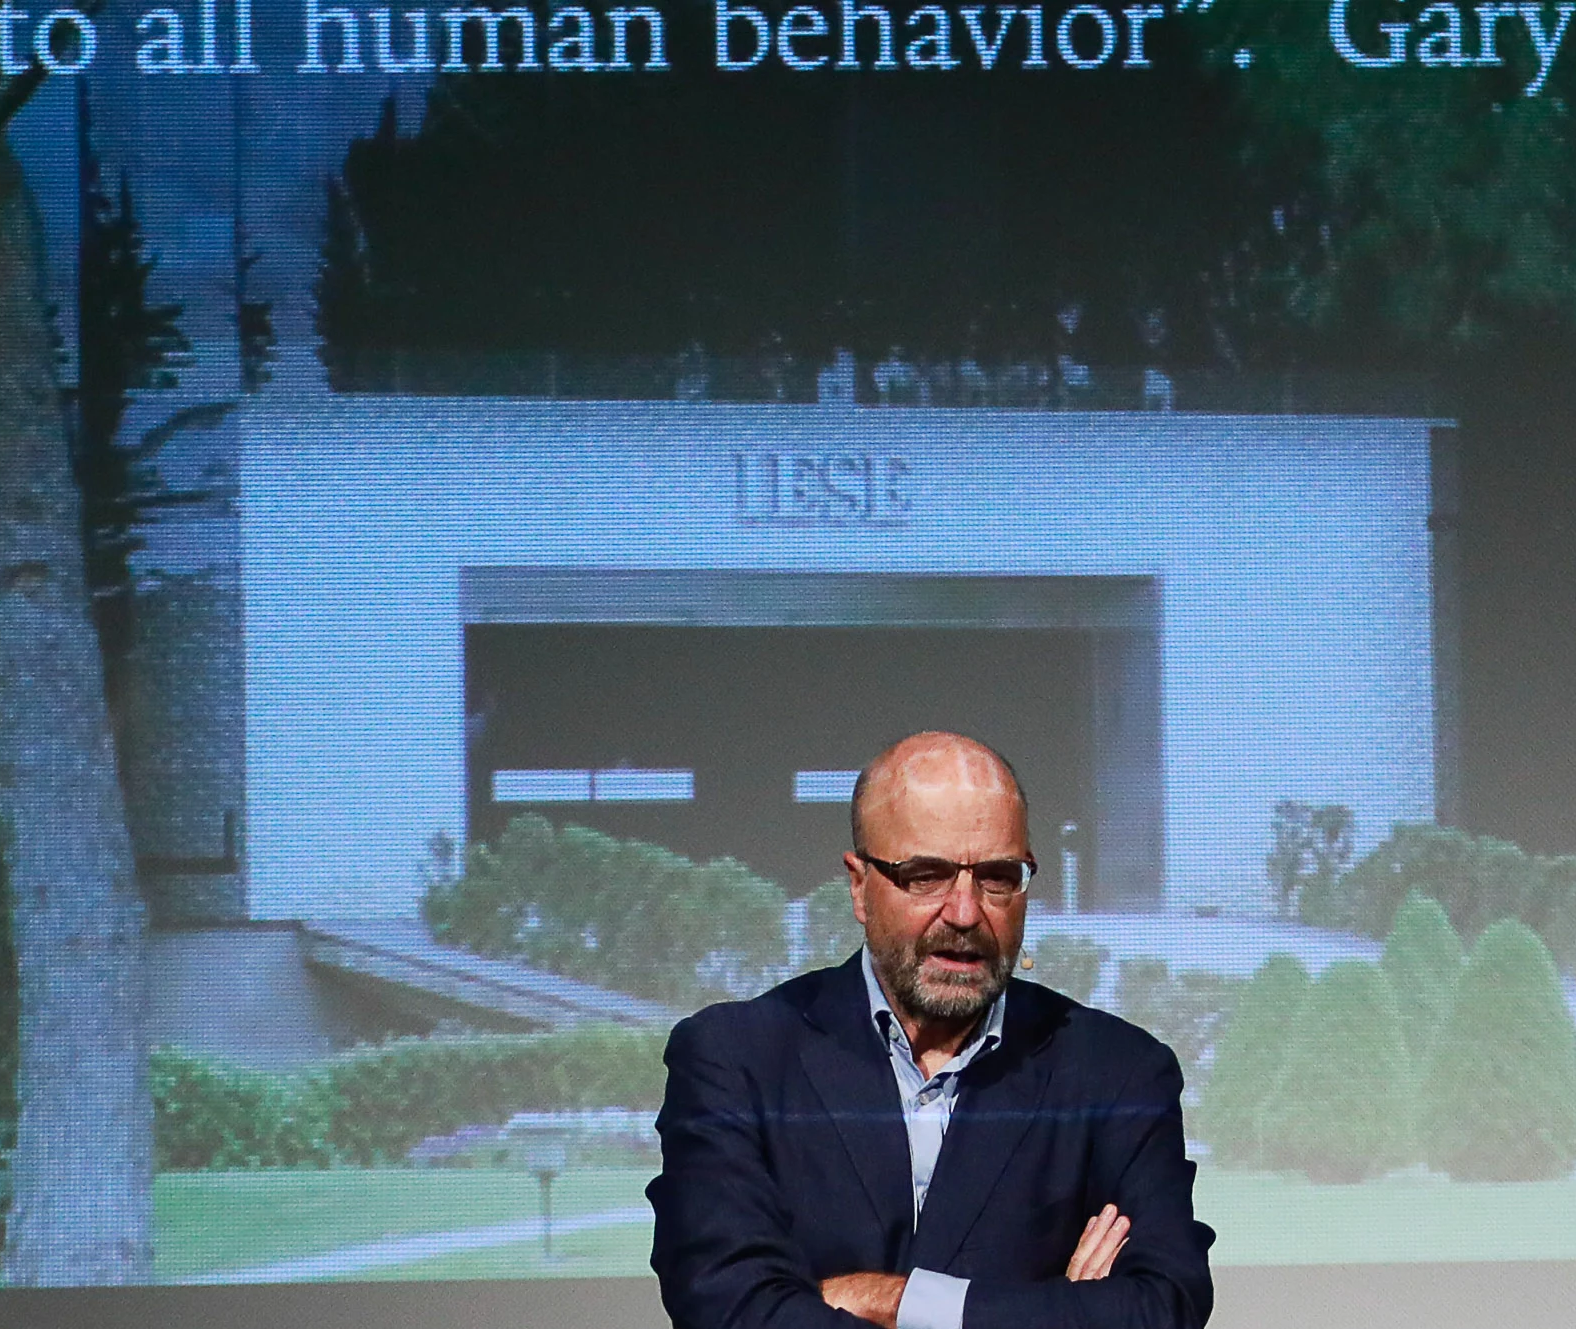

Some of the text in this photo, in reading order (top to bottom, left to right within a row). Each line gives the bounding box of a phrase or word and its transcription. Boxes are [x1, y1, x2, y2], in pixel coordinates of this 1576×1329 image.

[135, 0, 261, 74] all
[295, 0, 671, 73] human
[1325, 0, 1576, 98] Gary
